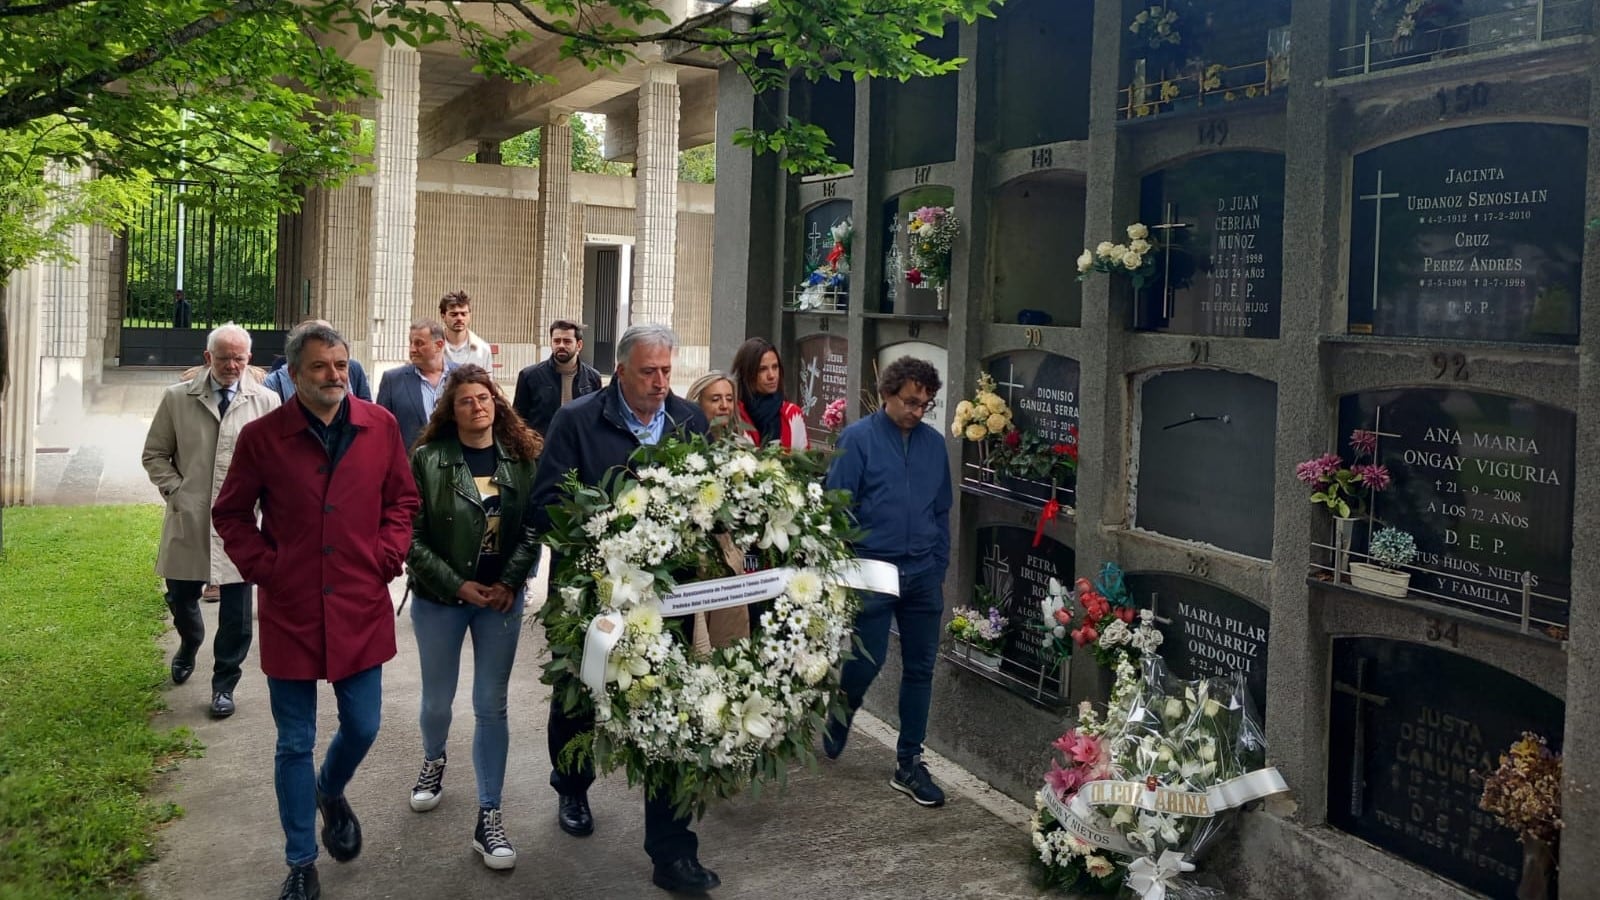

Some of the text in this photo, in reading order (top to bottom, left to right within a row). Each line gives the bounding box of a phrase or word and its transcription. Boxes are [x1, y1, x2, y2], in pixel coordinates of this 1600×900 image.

[1199, 119, 1228, 145] 149
[1032, 148, 1052, 167] 148
[1231, 195, 1258, 211] JUAN
[1215, 214, 1260, 231] CEBRIAN
[1218, 234, 1255, 250] MUÑOZ
[1215, 269, 1229, 279] LOS
[1245, 267, 1265, 279] AÑOS
[1245, 302, 1269, 313] HIJOS
[1024, 328, 1041, 346] 90
[1189, 342, 1209, 364] 91
[1432, 352, 1469, 381] 92
[1020, 398, 1052, 414] GANUZA
[1037, 387, 1074, 403] DIONISIO
[1424, 428, 1540, 454] ANA MARIA
[1404, 450, 1560, 486] ONGAY VIGURIA
[1493, 488, 1521, 504] 2008
[1428, 501, 1529, 528] A LOS 72 AÑOS
[1027, 554, 1058, 574] PETRA
[1416, 551, 1439, 566] TUS
[1438, 577, 1510, 605] Y FAMILIA
[1178, 602, 1266, 642] MARIA PILAR
[1426, 618, 1459, 648] 34
[1184, 621, 1257, 657] MUNARRIZ
[1188, 640, 1251, 673] ORDOQUI
[1416, 705, 1482, 744] JUSTA
[1064, 812, 1071, 823] Y
[1070, 819, 1110, 845] NIETOS
